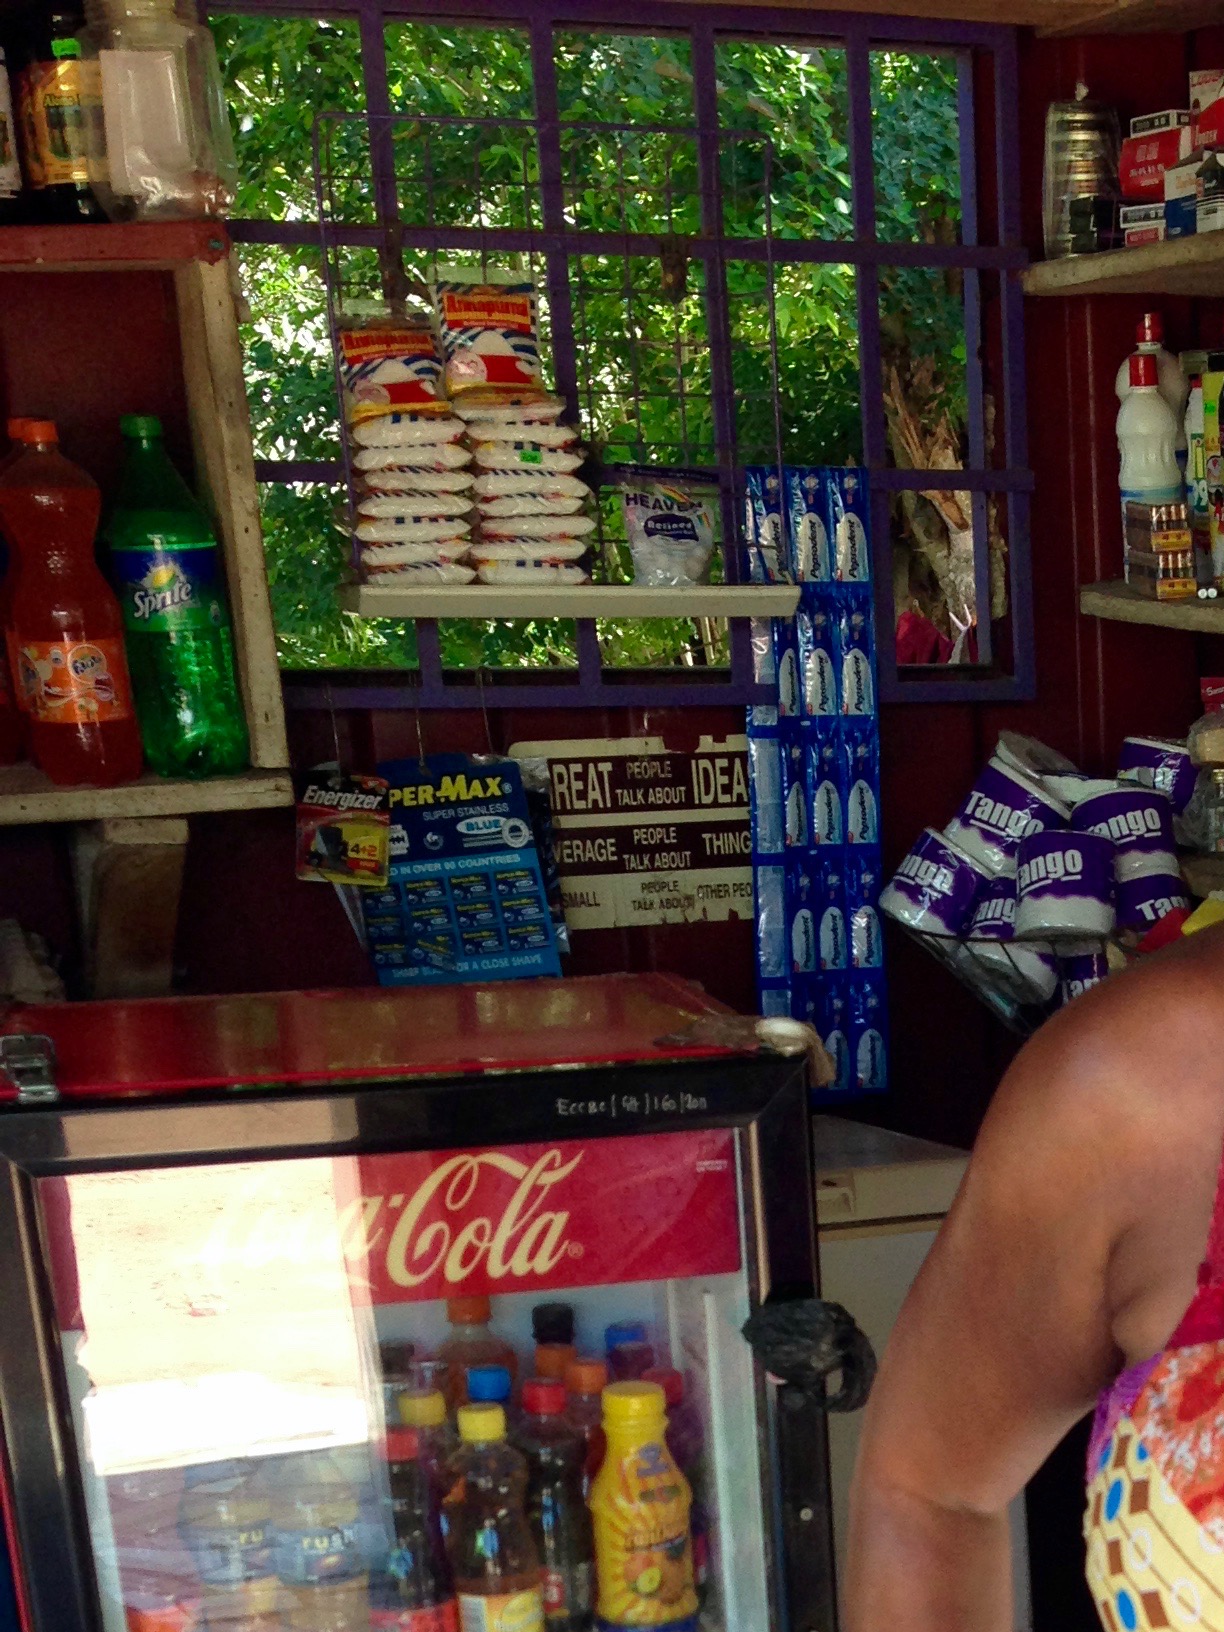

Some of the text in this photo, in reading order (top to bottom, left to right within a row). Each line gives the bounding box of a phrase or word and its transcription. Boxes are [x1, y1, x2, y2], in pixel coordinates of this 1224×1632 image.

[133, 582, 193, 619] Sprite
[626, 760, 674, 780] PEOPLE
[691, 757, 750, 805] IDEA
[301, 784, 383, 812] Energizer
[389, 774, 502, 808] PER-MAX
[551, 762, 614, 811] REAT
[615, 786, 687, 807] TALK ABOUT
[423, 807, 455, 822] SUPER
[965, 789, 1046, 842] Tango
[1086, 805, 1164, 845] ango
[633, 826, 678, 846] PEOPLE
[702, 830, 750, 856] THING
[553, 837, 618, 865] VERAGE
[623, 850, 692, 871] TALK ABOUT
[641, 880, 680, 894] PEOPLE
[892, 853, 955, 899] ango
[732, 882, 753, 899] PEO
[973, 895, 1015, 926] ang
[1135, 895, 1192, 922] Tan
